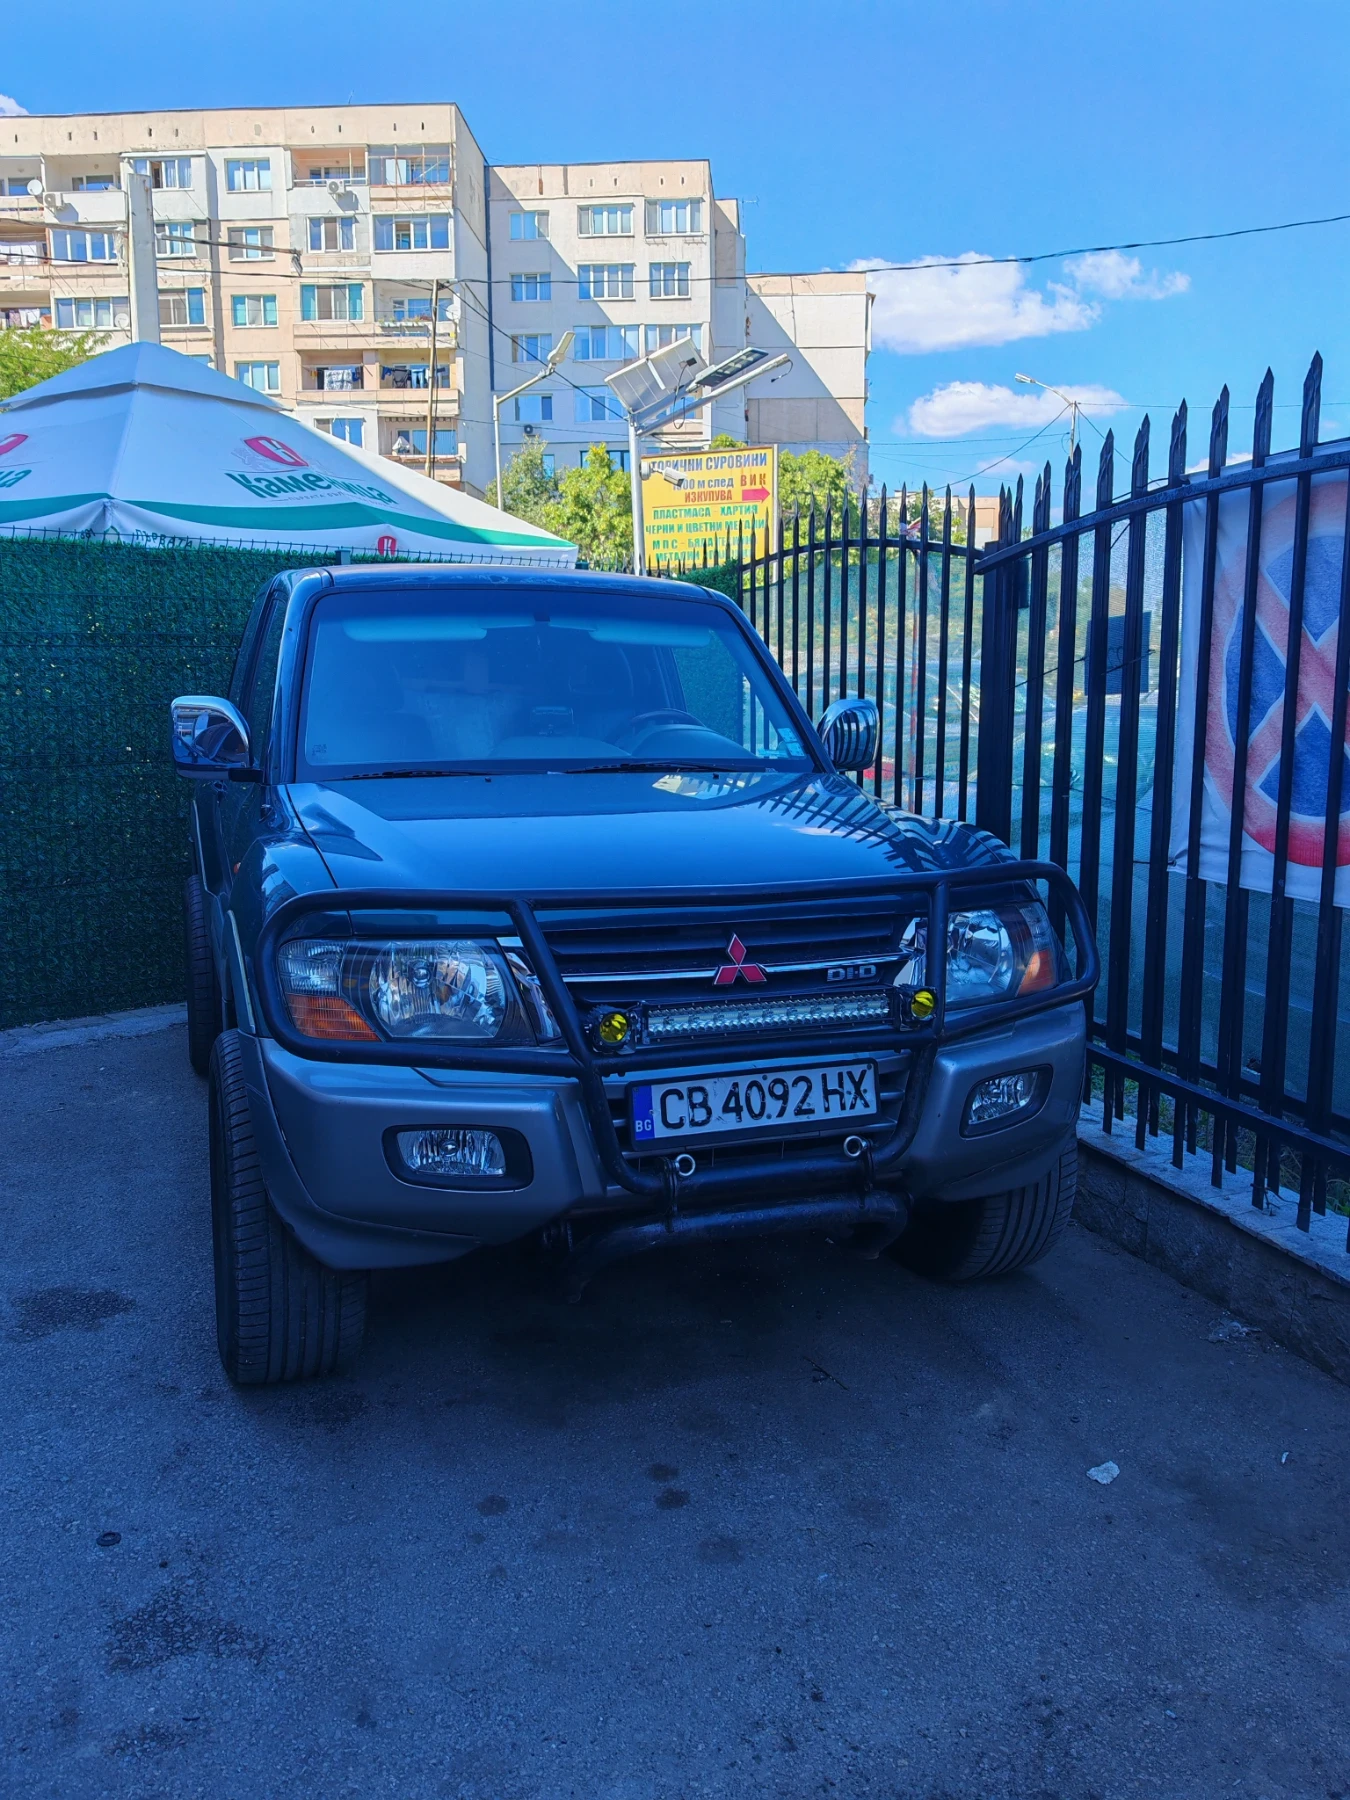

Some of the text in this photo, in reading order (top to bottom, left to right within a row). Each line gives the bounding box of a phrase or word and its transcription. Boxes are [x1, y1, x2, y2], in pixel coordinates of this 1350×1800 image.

[650, 453, 767, 472] ТОРИЧНИ СУРОВИНИ
[224, 472, 399, 505] Каменица
[707, 477, 734, 489] след
[684, 490, 733, 503] ИЗКУПУВА
[653, 507, 711, 520] ПЛАСТМАСА
[645, 524, 675, 535] ЧЕРНИ
[686, 522, 723, 533] ЦВЕТНИ
[660, 1069, 871, 1129] CB 4092 HX
[635, 1119, 652, 1133] BG
